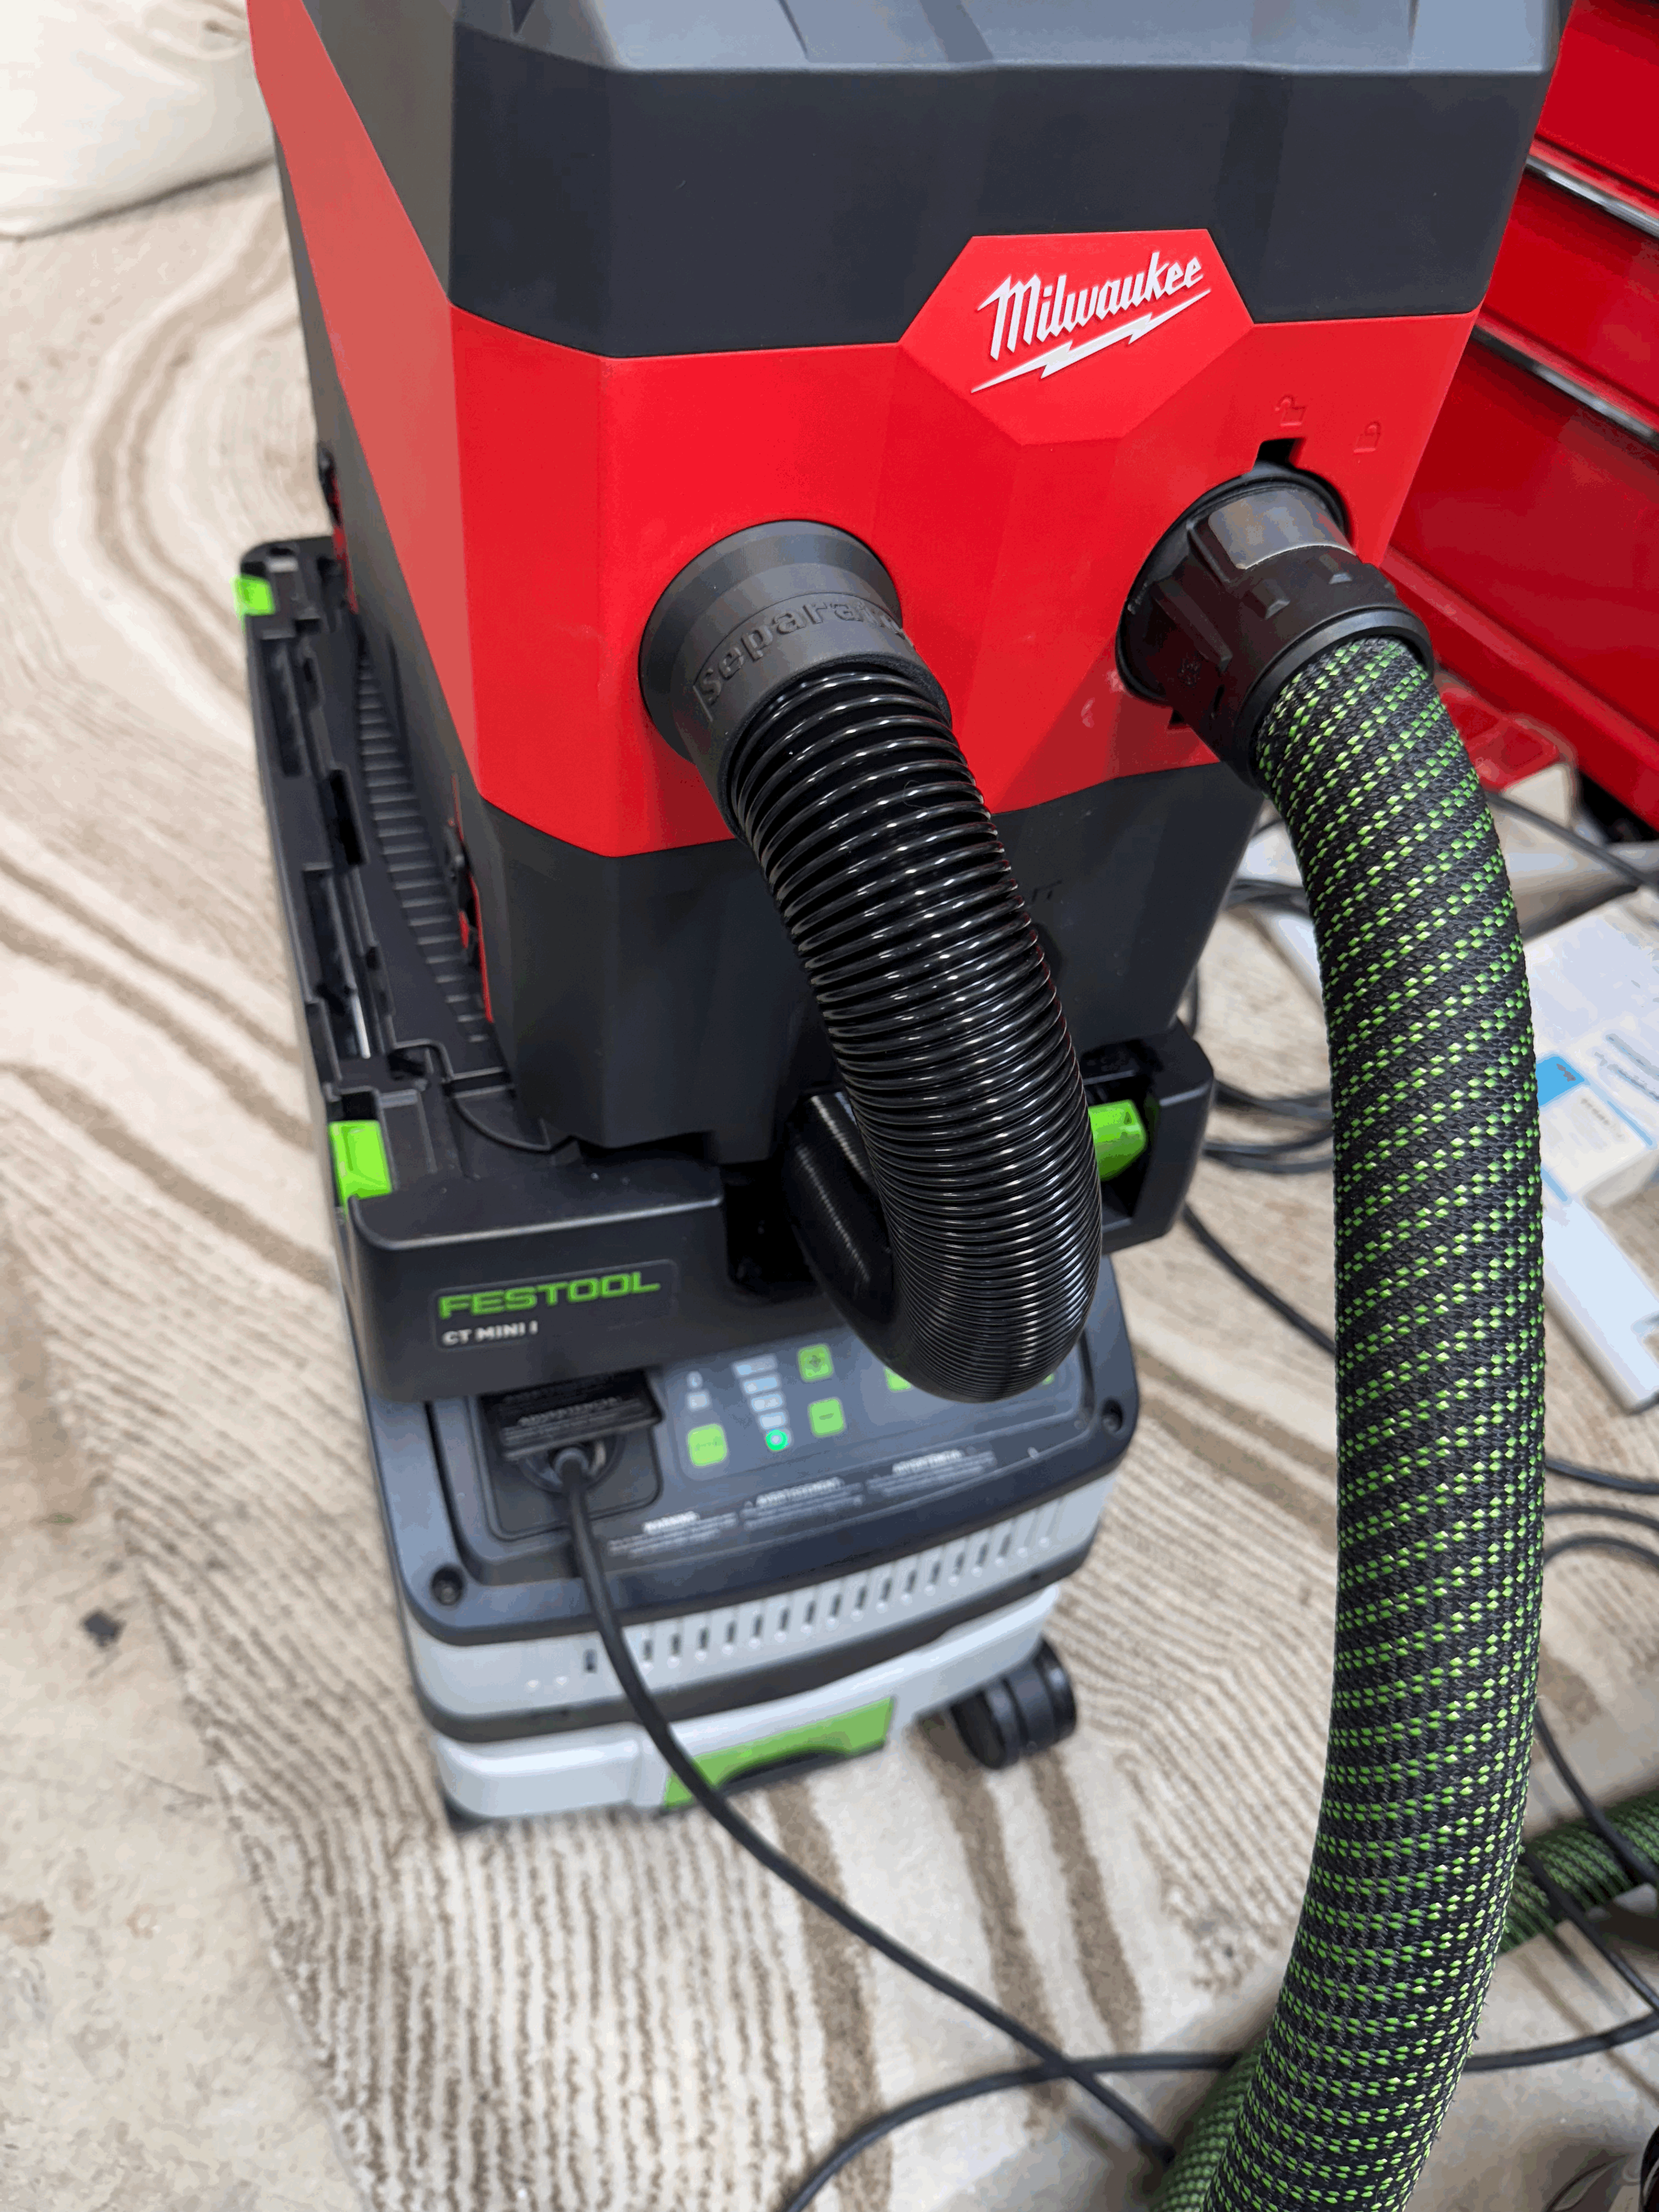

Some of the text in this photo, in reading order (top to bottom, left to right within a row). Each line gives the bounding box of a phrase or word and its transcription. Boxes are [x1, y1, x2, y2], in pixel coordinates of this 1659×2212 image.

[977, 250, 1205, 362] Milwaukee
[701, 600, 913, 708] separat
[439, 1271, 661, 1320] FESTOOL
[443, 1328, 473, 1346] CT
[475, 1322, 526, 1342] MINI
